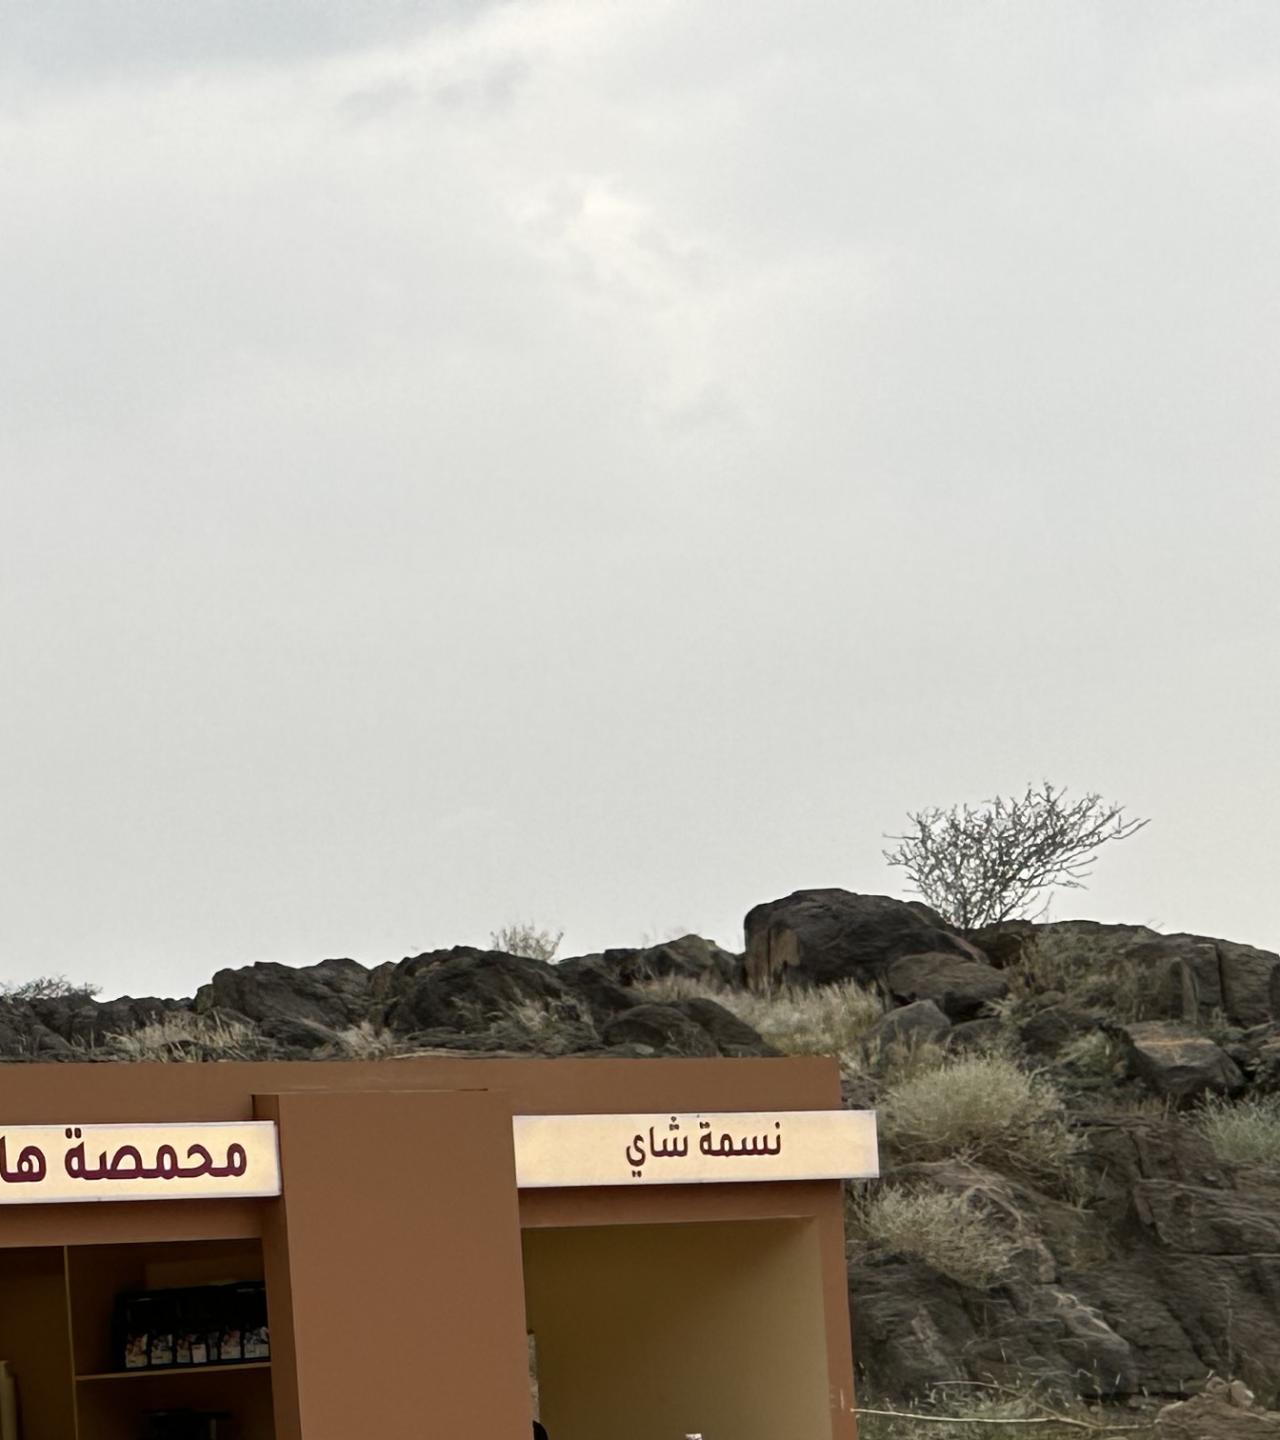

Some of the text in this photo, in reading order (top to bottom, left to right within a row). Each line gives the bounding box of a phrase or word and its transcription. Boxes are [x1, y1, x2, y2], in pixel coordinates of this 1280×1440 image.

[64, 1126, 248, 1181] محمصة
[625, 1115, 782, 1178] نسمة شاي
